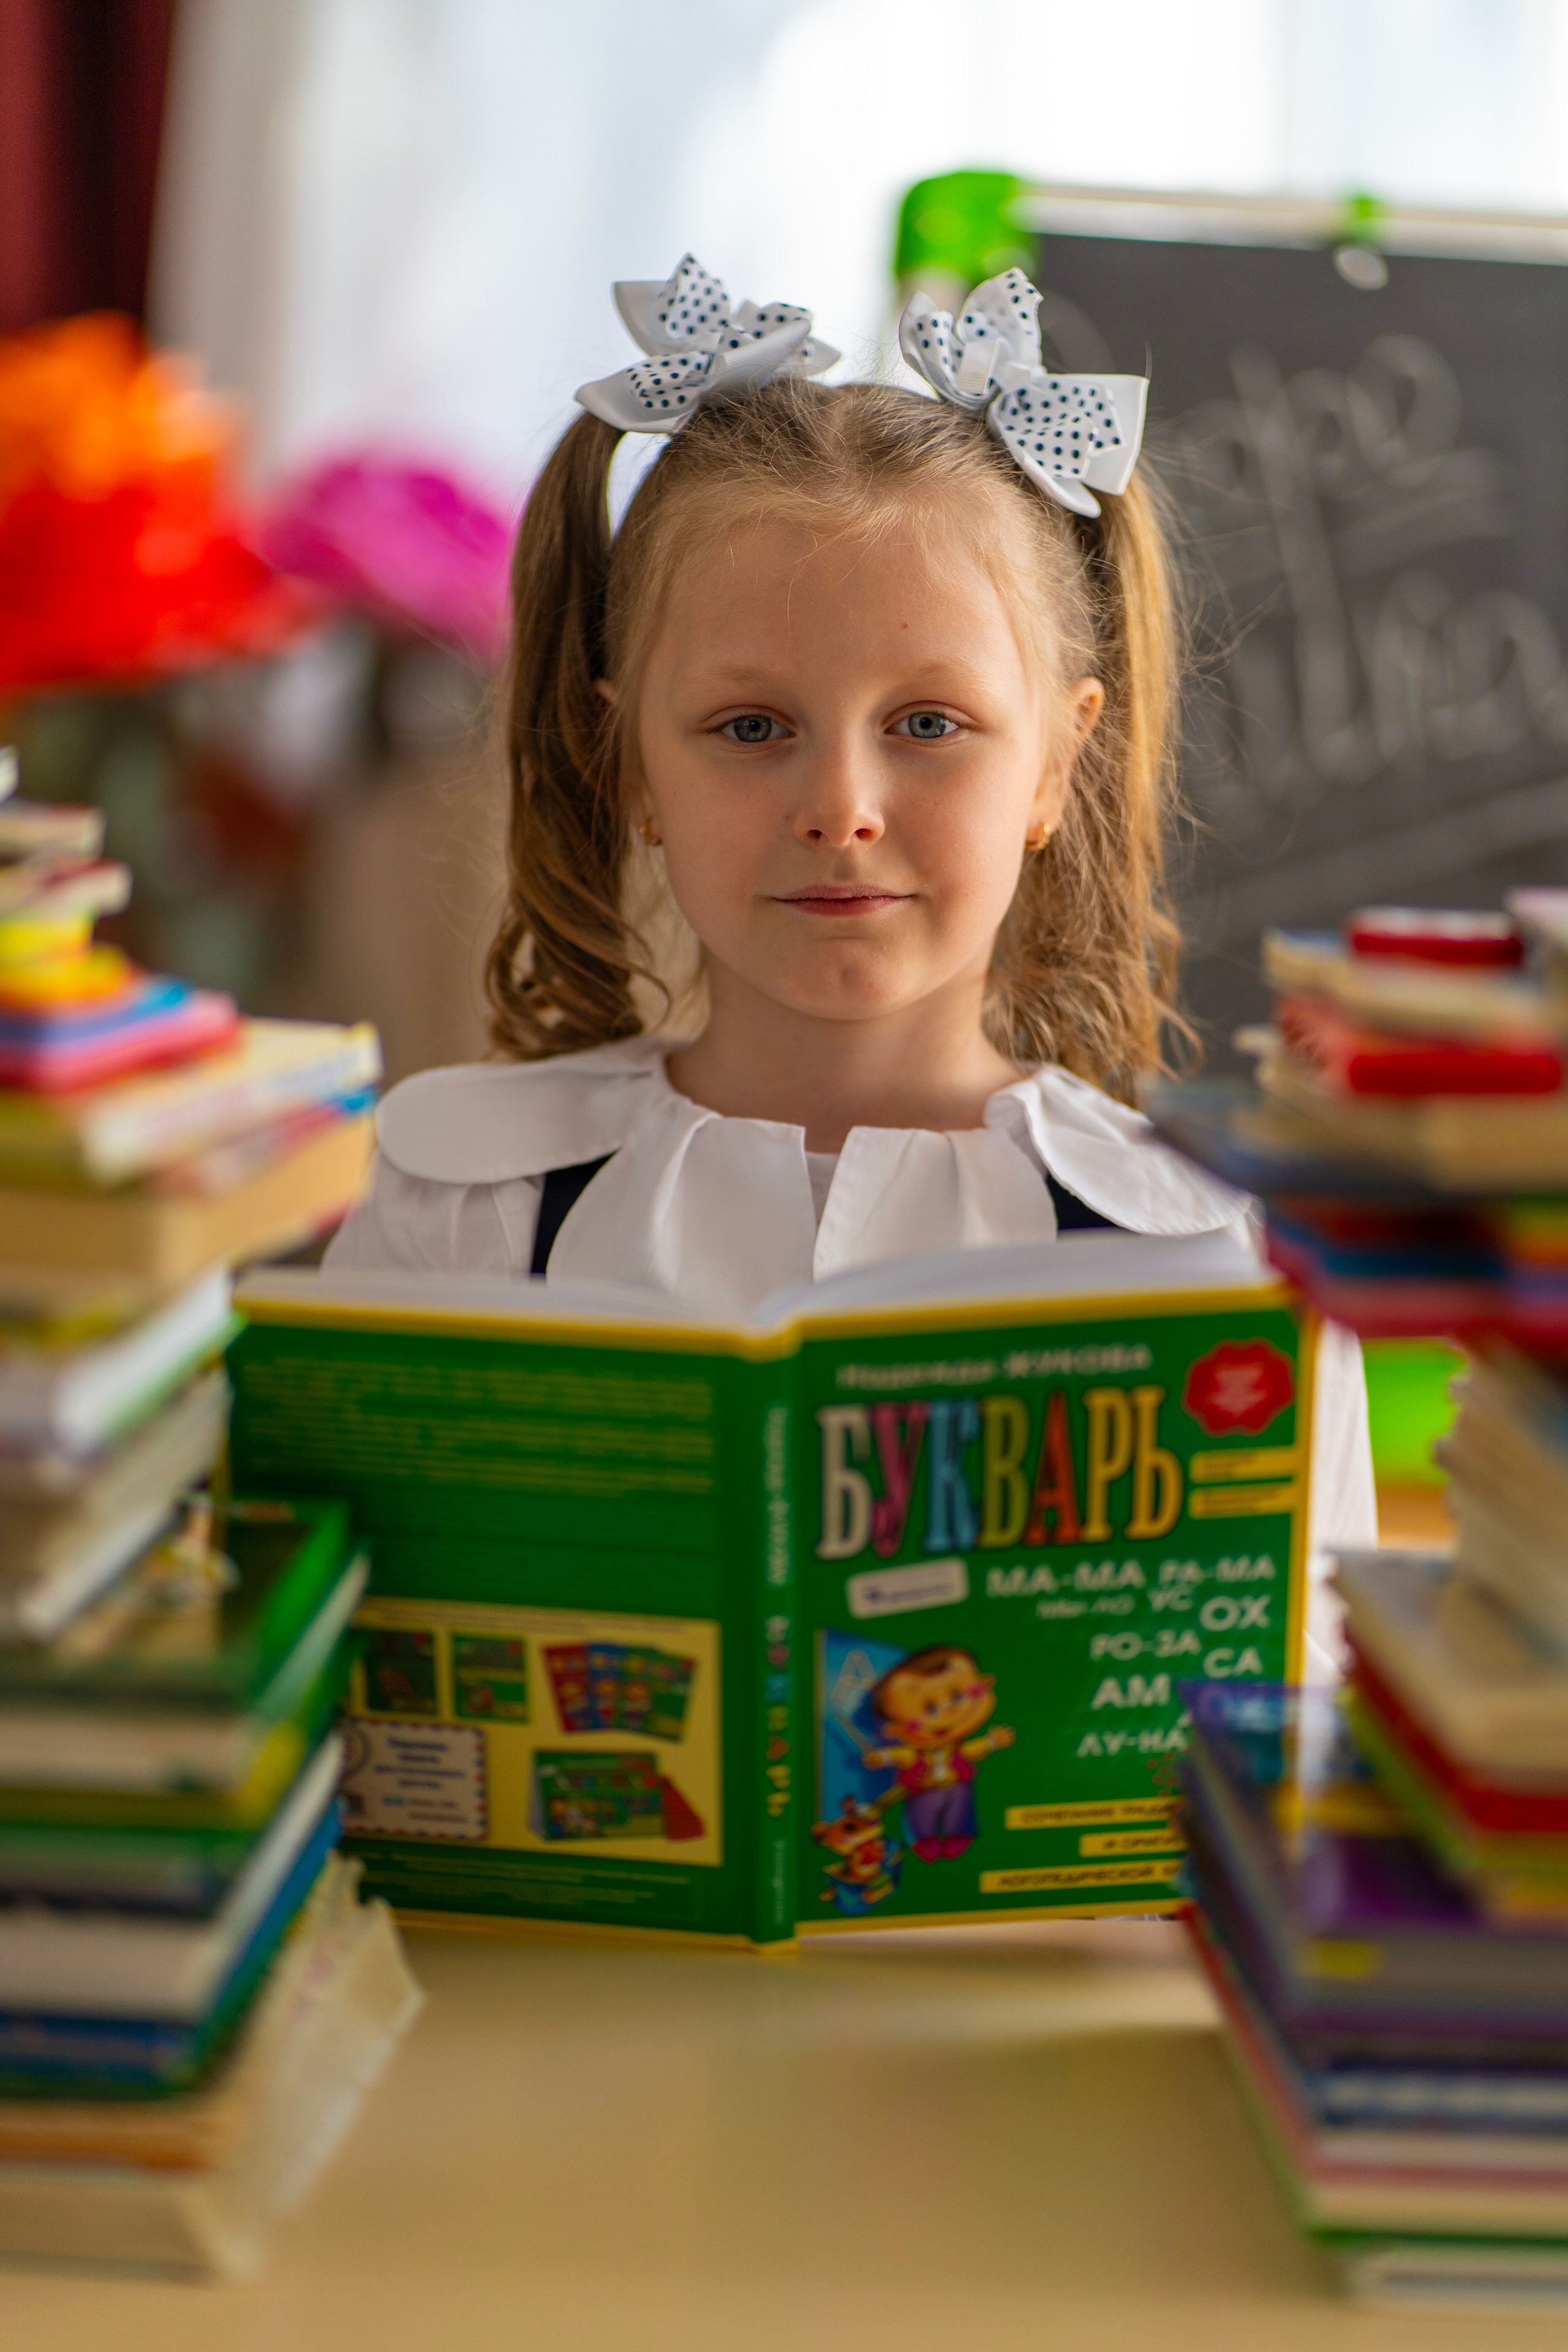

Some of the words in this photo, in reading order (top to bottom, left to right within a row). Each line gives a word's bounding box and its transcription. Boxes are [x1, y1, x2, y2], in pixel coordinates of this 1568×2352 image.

[1003, 1343, 1153, 1379] ЖУКОВА
[815, 1384, 1184, 1560] БУКВАРЬ
[986, 1558, 1147, 1597] МА-МА
[1159, 1555, 1276, 1586] РА-МА
[1147, 1586, 1193, 1612] УС
[1199, 1594, 1272, 1632] ОХ
[1090, 1629, 1202, 1661] РО-ЗА
[1203, 1646, 1264, 1678] СА
[1090, 1672, 1171, 1711] АМ
